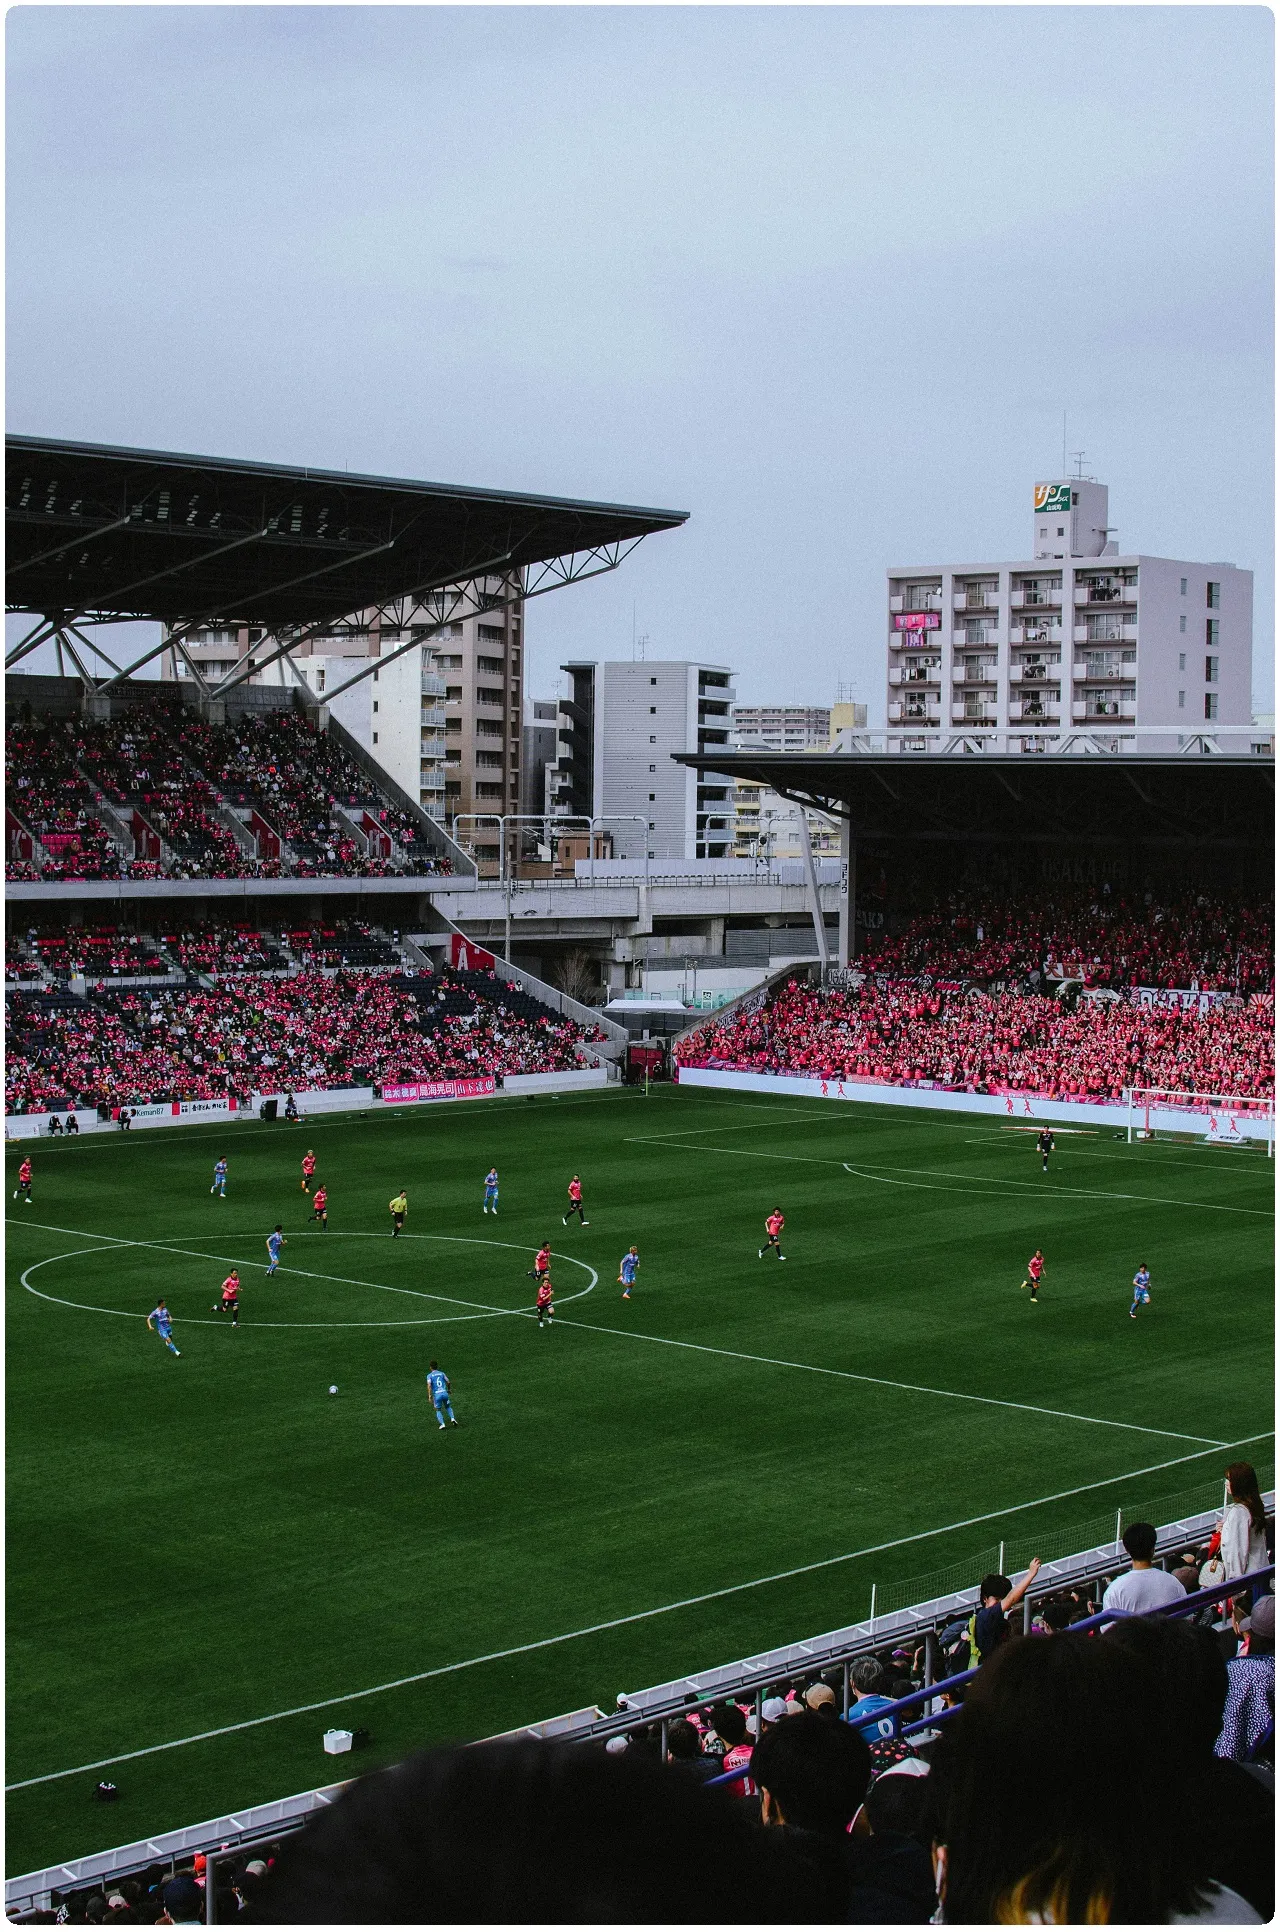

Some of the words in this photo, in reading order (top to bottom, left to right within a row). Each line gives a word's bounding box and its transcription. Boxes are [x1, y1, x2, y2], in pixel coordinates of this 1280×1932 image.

[420, 1082, 455, 1096] 鳥海晃司
[458, 1080, 494, 1095] 山下達也
[136, 1107, 164, 1117] Keman87
[436, 1376, 443, 1388] 6
